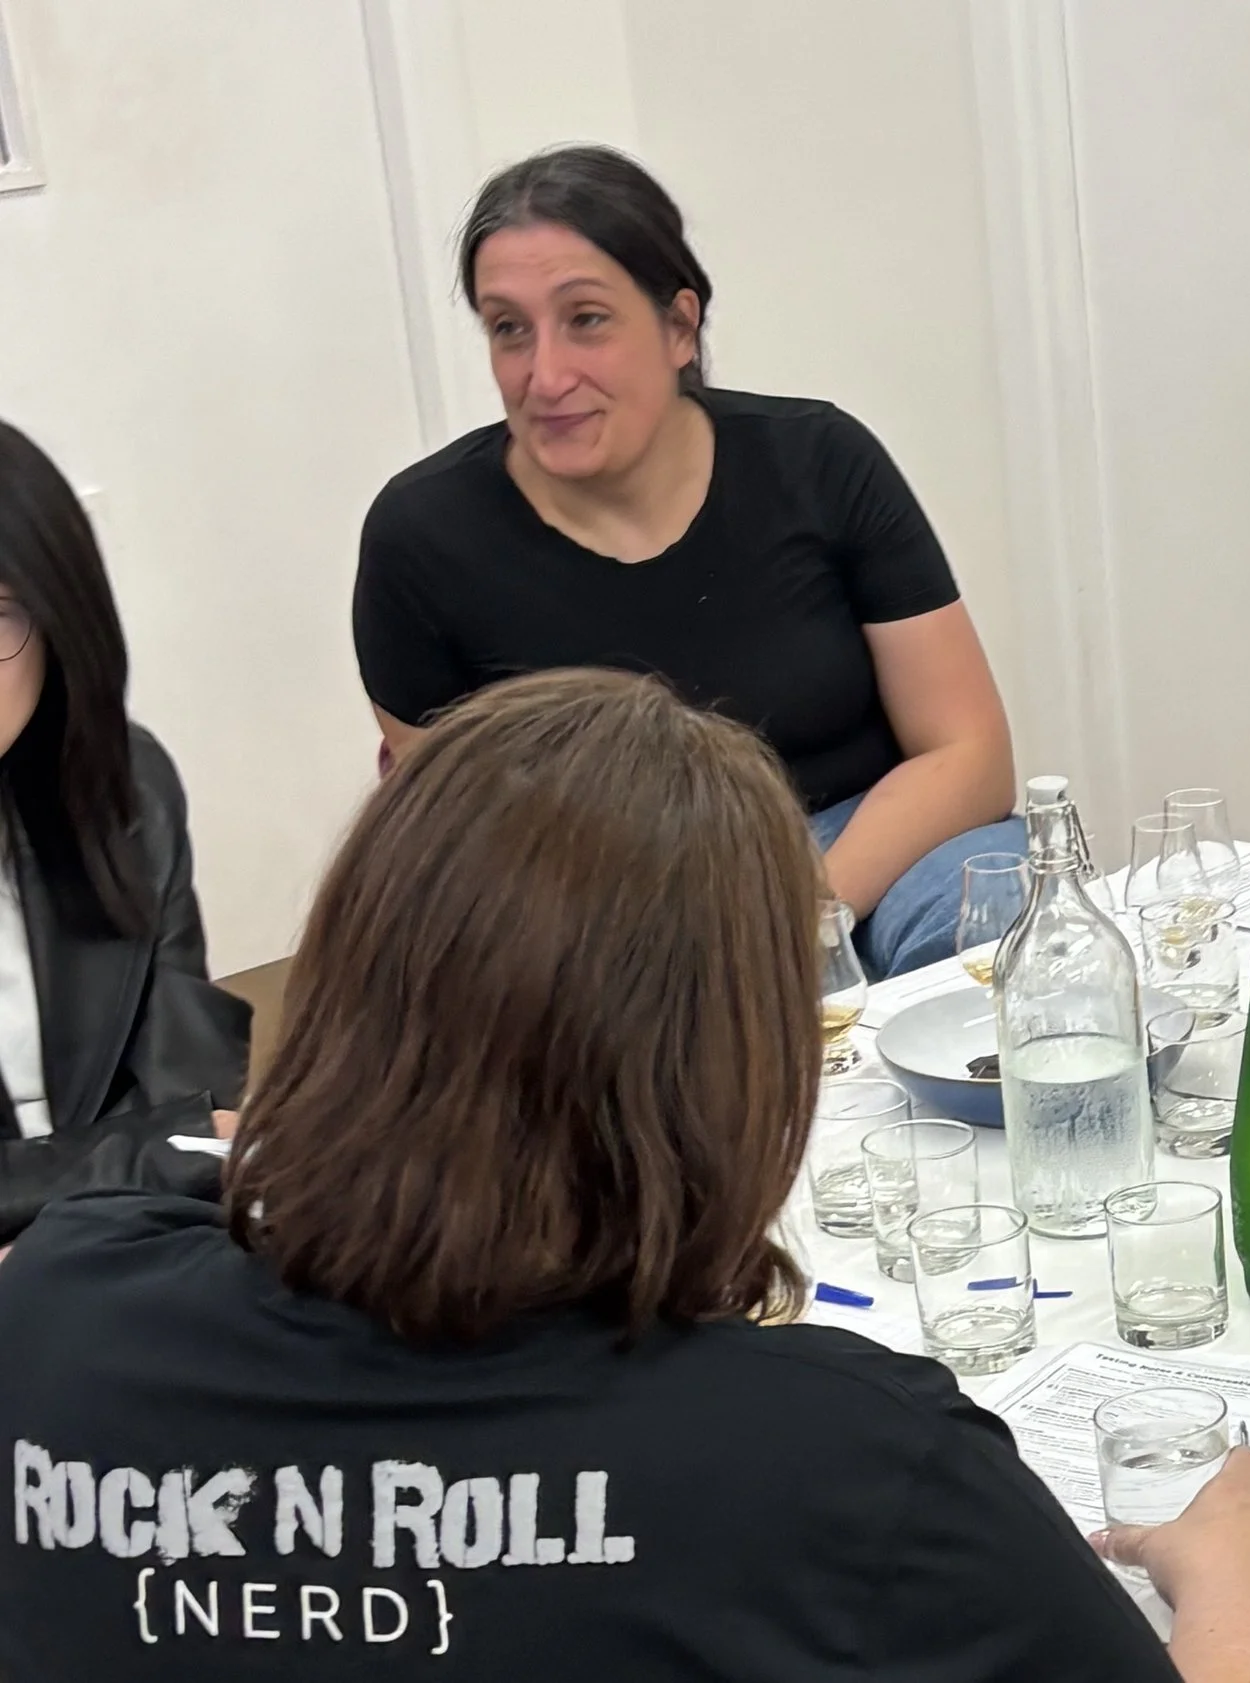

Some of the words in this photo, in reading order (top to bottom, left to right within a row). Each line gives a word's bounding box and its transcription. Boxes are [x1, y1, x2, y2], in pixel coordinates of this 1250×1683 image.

[14, 1439, 256, 1565] ROCK
[274, 1465, 344, 1557] N
[371, 1459, 635, 1569] ROLL
